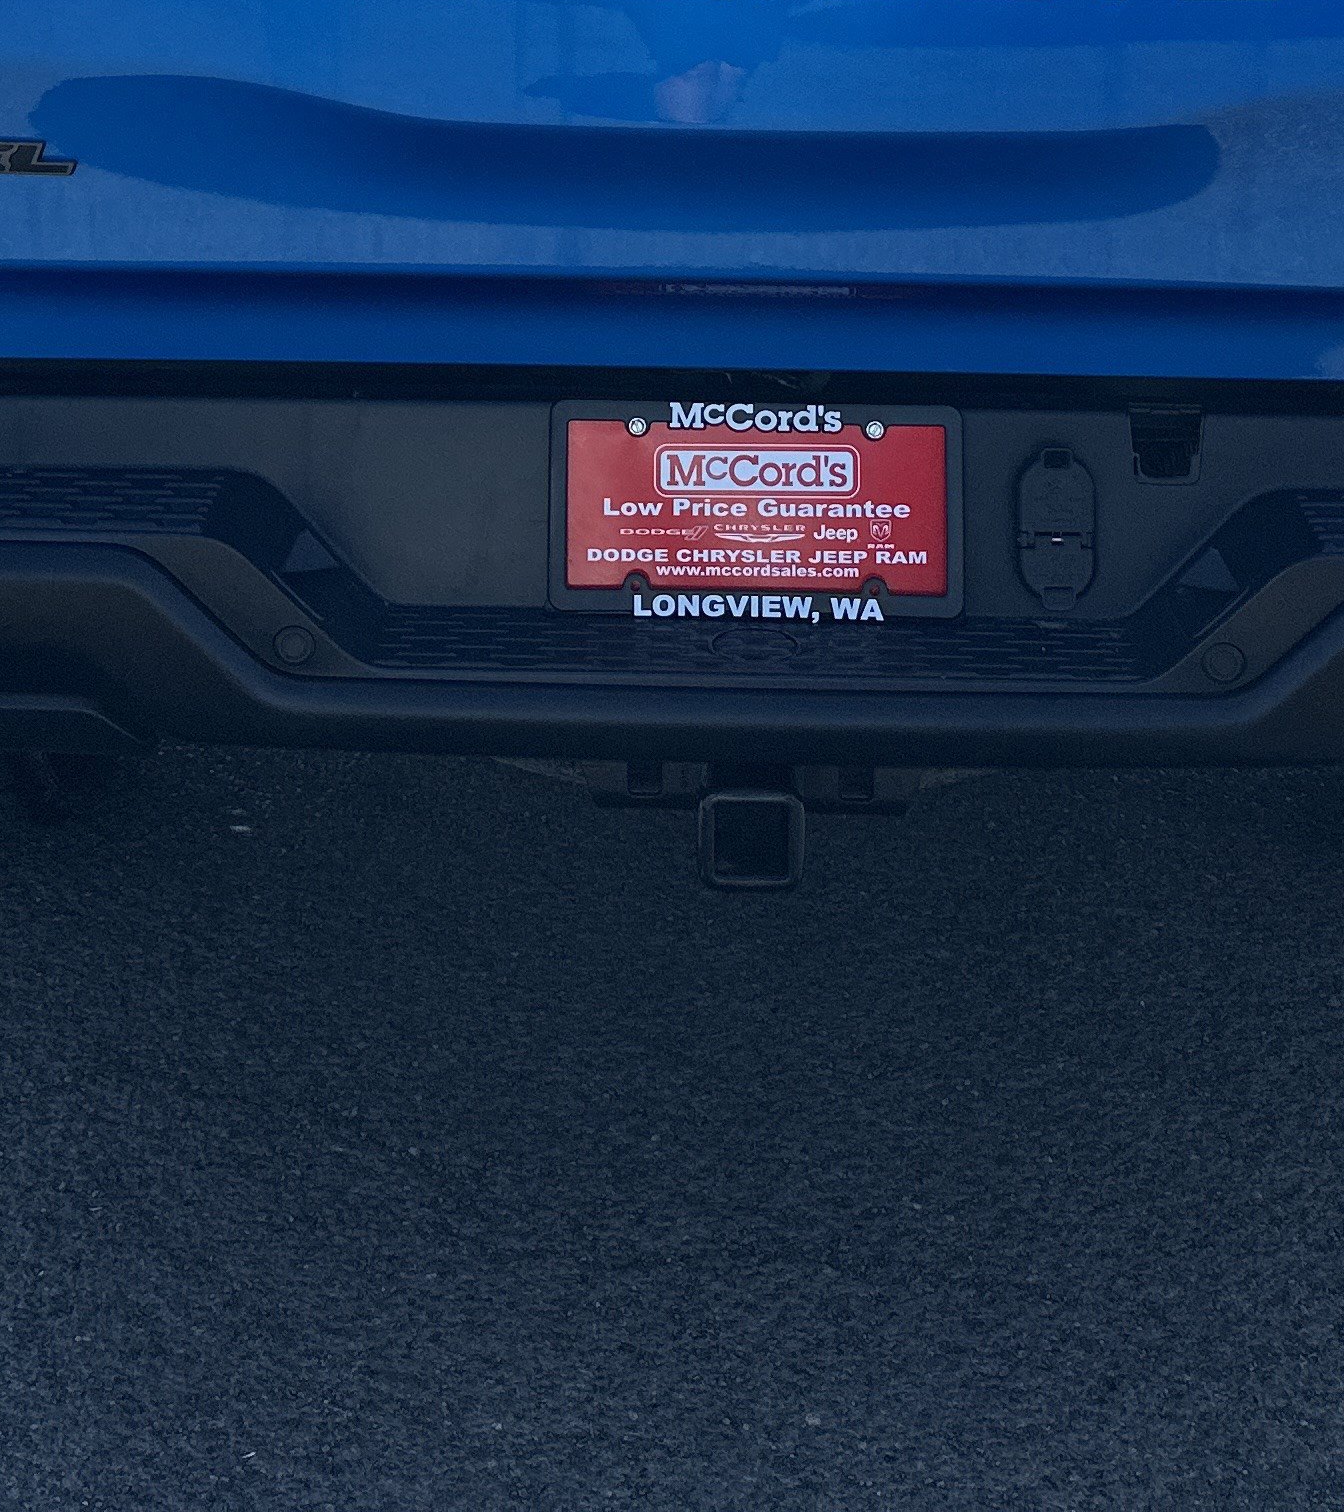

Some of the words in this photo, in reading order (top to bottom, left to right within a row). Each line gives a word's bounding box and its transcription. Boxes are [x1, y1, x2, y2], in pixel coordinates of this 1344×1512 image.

[669, 401, 842, 433] McCord's
[666, 454, 848, 488] McCord's
[603, 498, 664, 517] Low
[673, 498, 748, 518] Price
[757, 498, 911, 519] Guarantee
[619, 528, 694, 536] DODGE
[713, 523, 806, 532] CHRYSLER
[813, 524, 859, 544] Jeep
[587, 548, 670, 563] DODGE
[676, 548, 802, 564] CHRYSLER
[808, 550, 868, 565] JEEP
[875, 550, 928, 565] RAM
[656, 563, 860, 579] www.mccordsales.com
[632, 594, 821, 624] LONGVIEW,
[830, 597, 885, 622] WA
